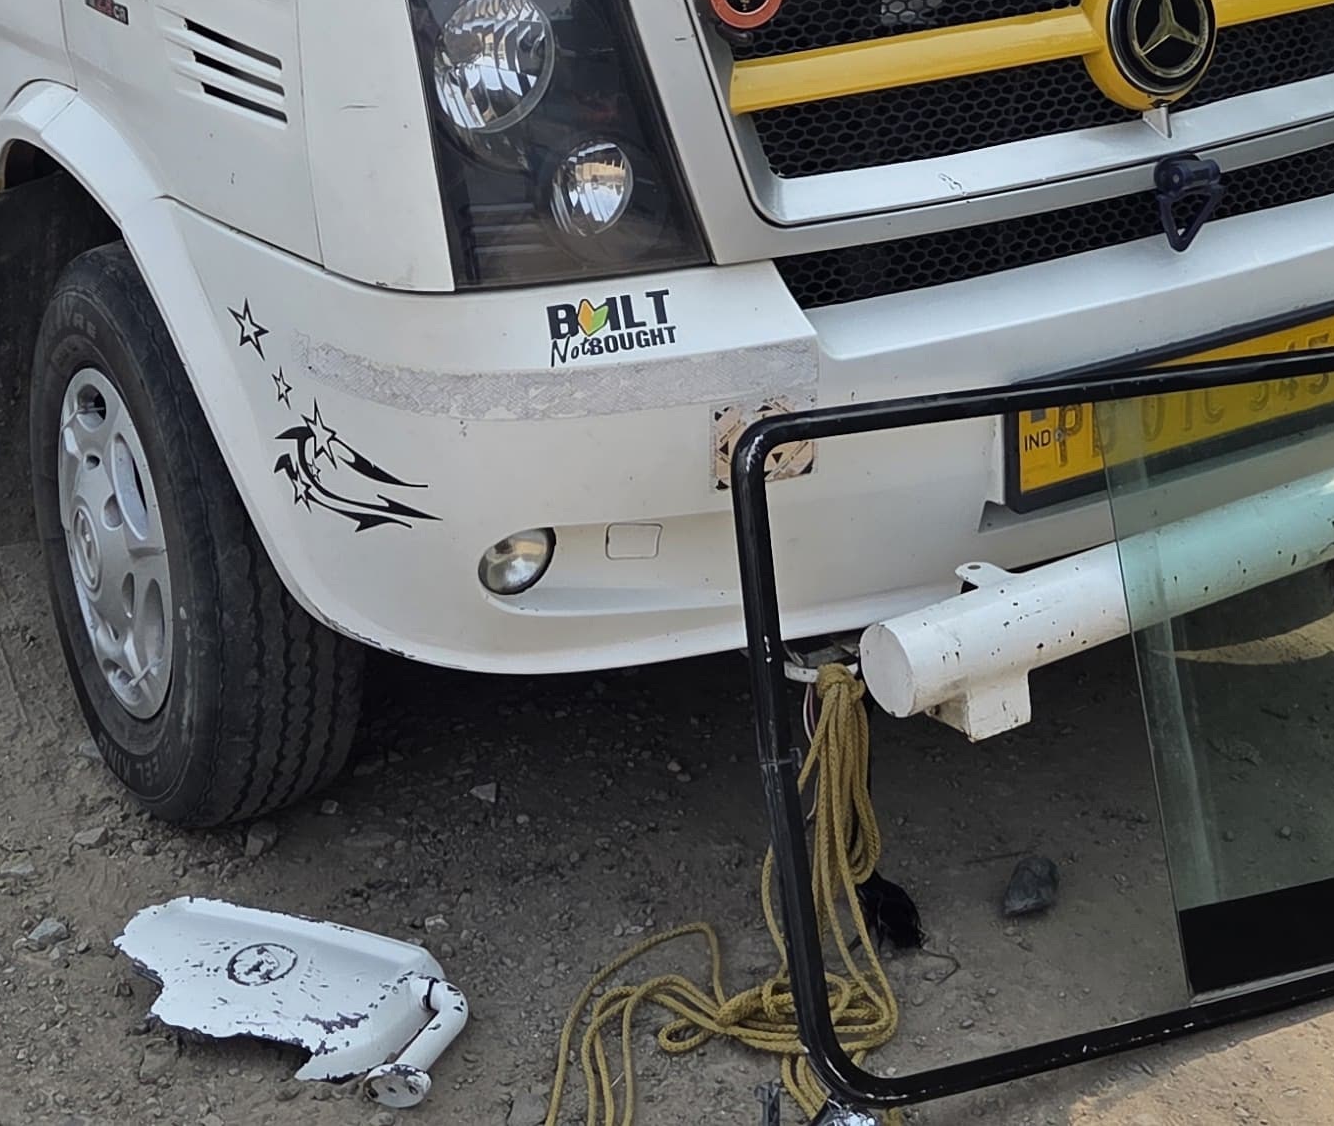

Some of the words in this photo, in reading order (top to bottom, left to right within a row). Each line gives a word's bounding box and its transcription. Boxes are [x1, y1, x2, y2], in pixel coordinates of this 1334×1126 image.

[551, 335, 591, 368] Not
[589, 326, 676, 356] BOUGHT
[1024, 429, 1052, 452] IND
